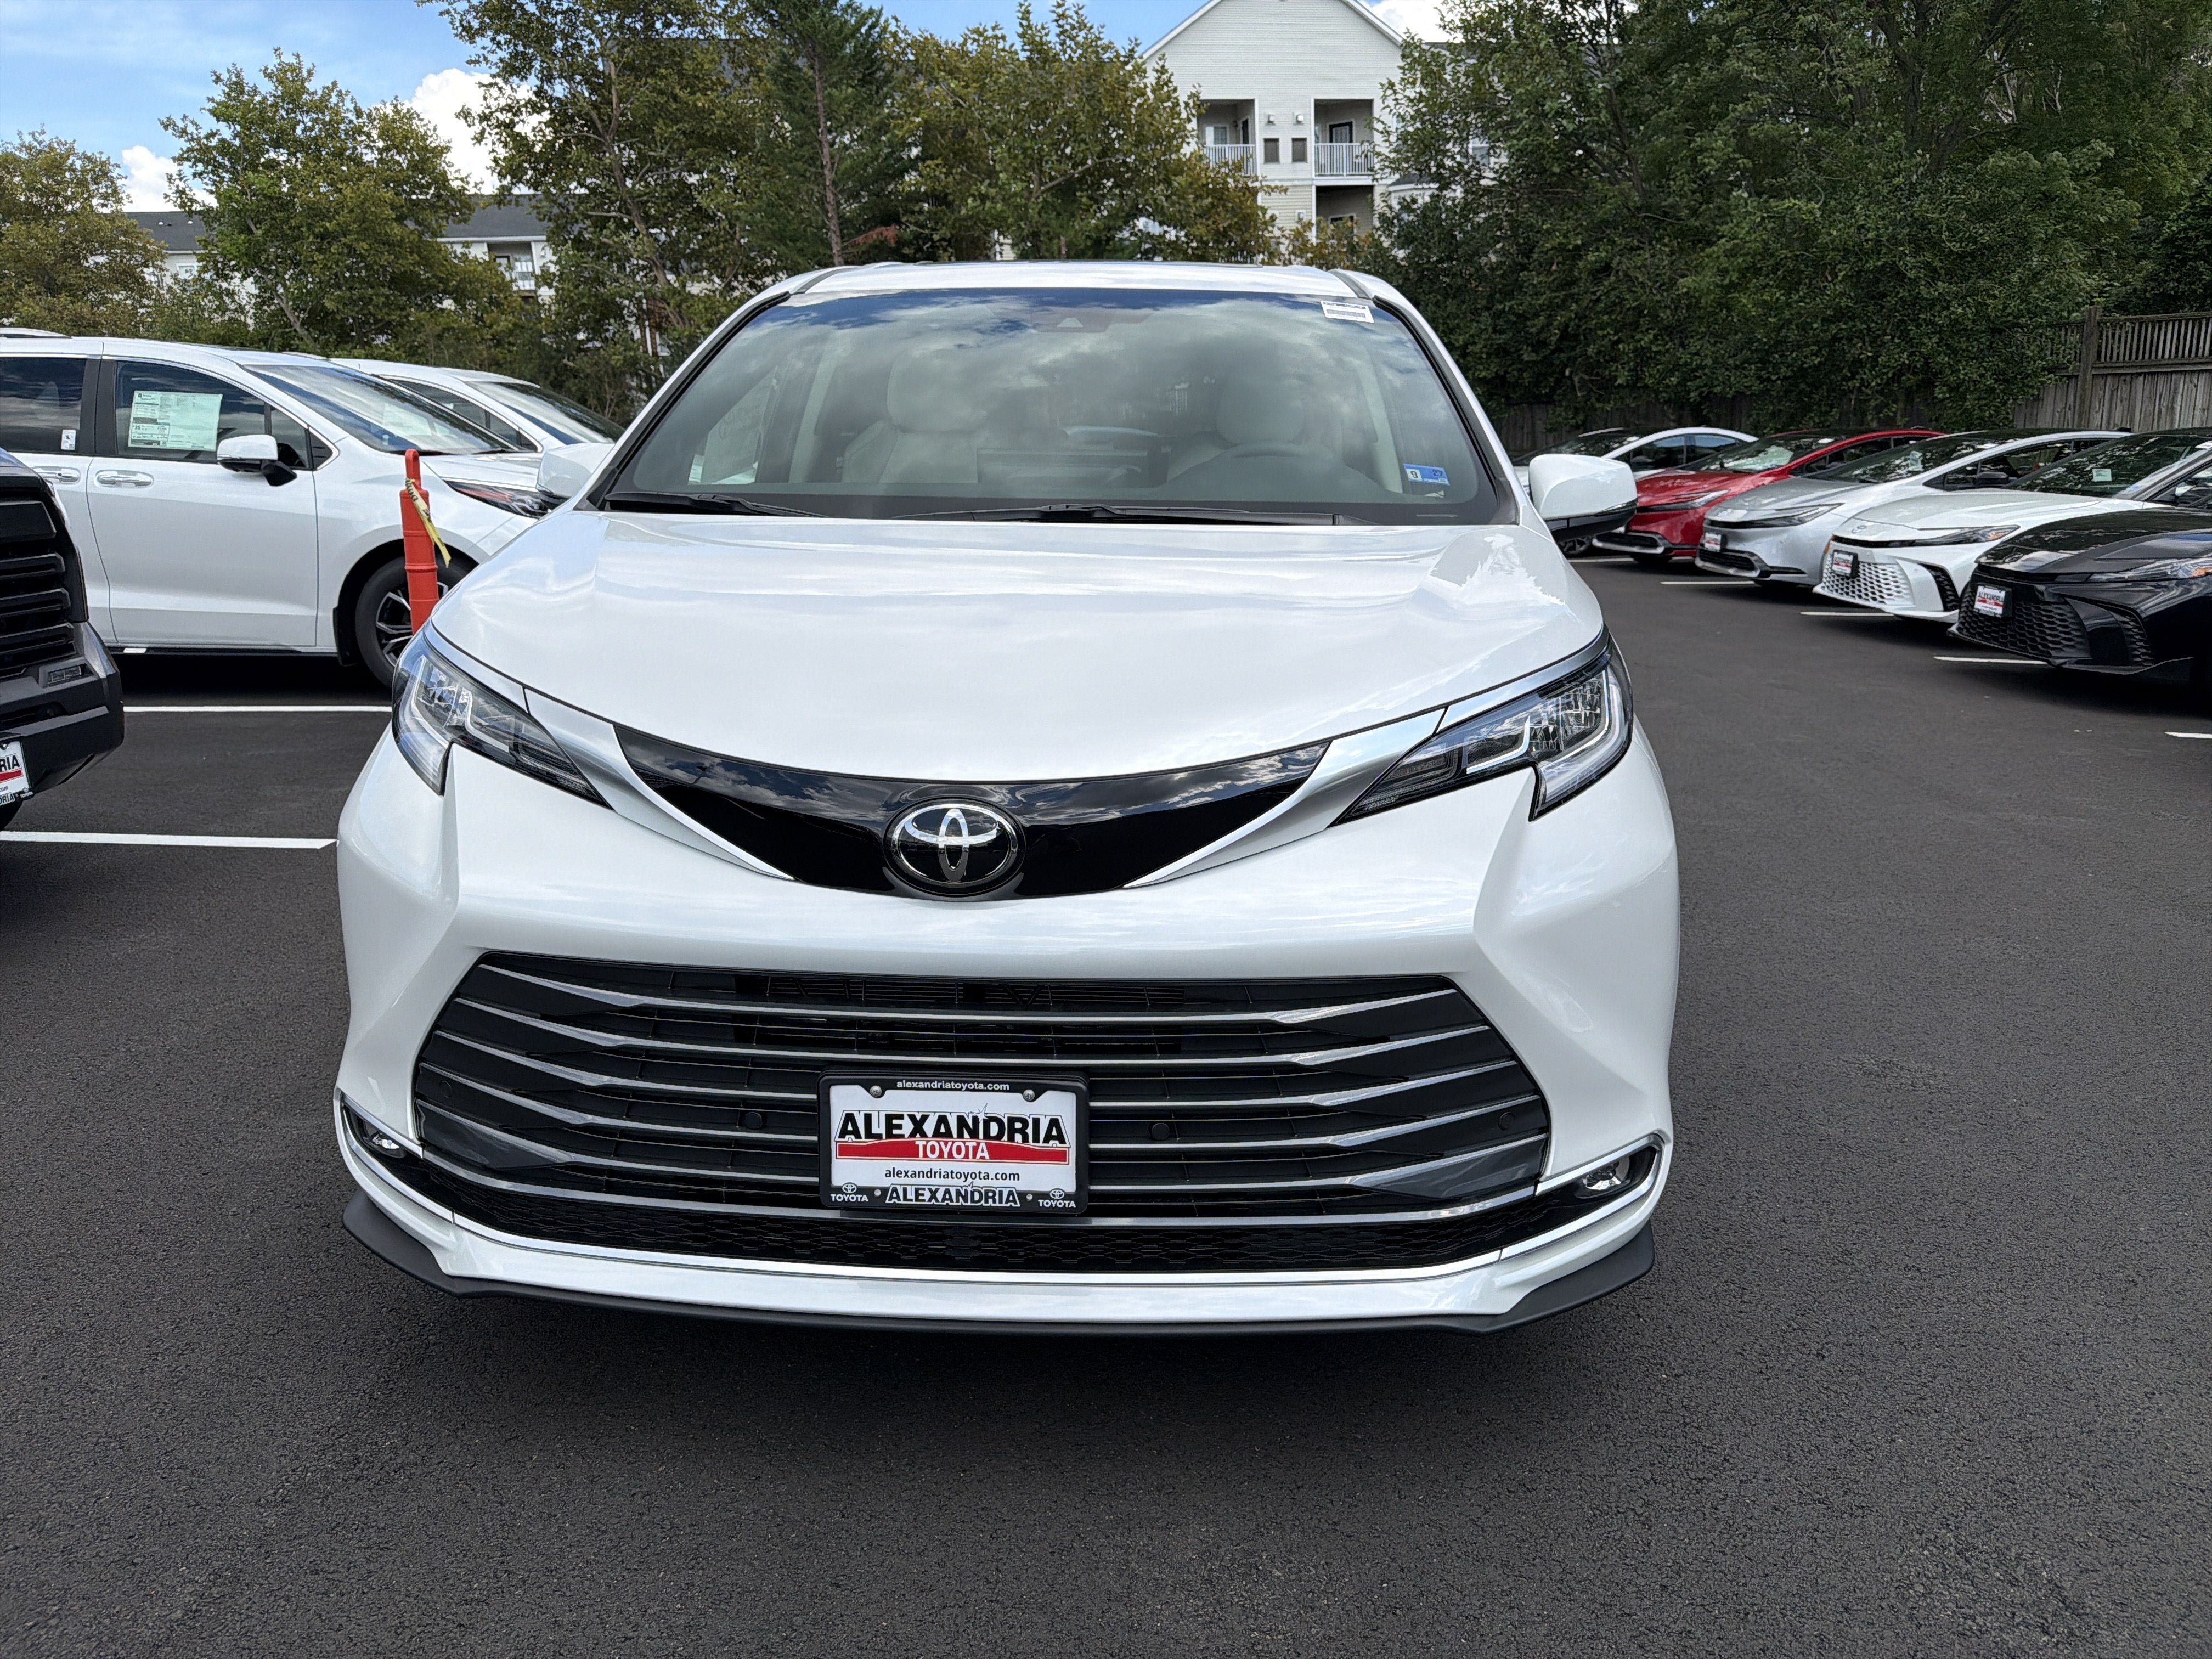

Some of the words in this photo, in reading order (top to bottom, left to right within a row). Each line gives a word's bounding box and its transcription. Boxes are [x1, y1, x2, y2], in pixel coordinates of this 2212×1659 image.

[896, 1080, 1009, 1091] alexandriatoyota.com
[837, 1111, 1068, 1145] ALEXANDRIA
[915, 1141, 990, 1159] TOYOTA
[884, 1167, 1020, 1182] alexandriatoyota.com
[830, 1194, 868, 1202] TOYOTA
[886, 1184, 1020, 1206] ALEXANDRIA
[1038, 1199, 1076, 1207] TOYOTA
